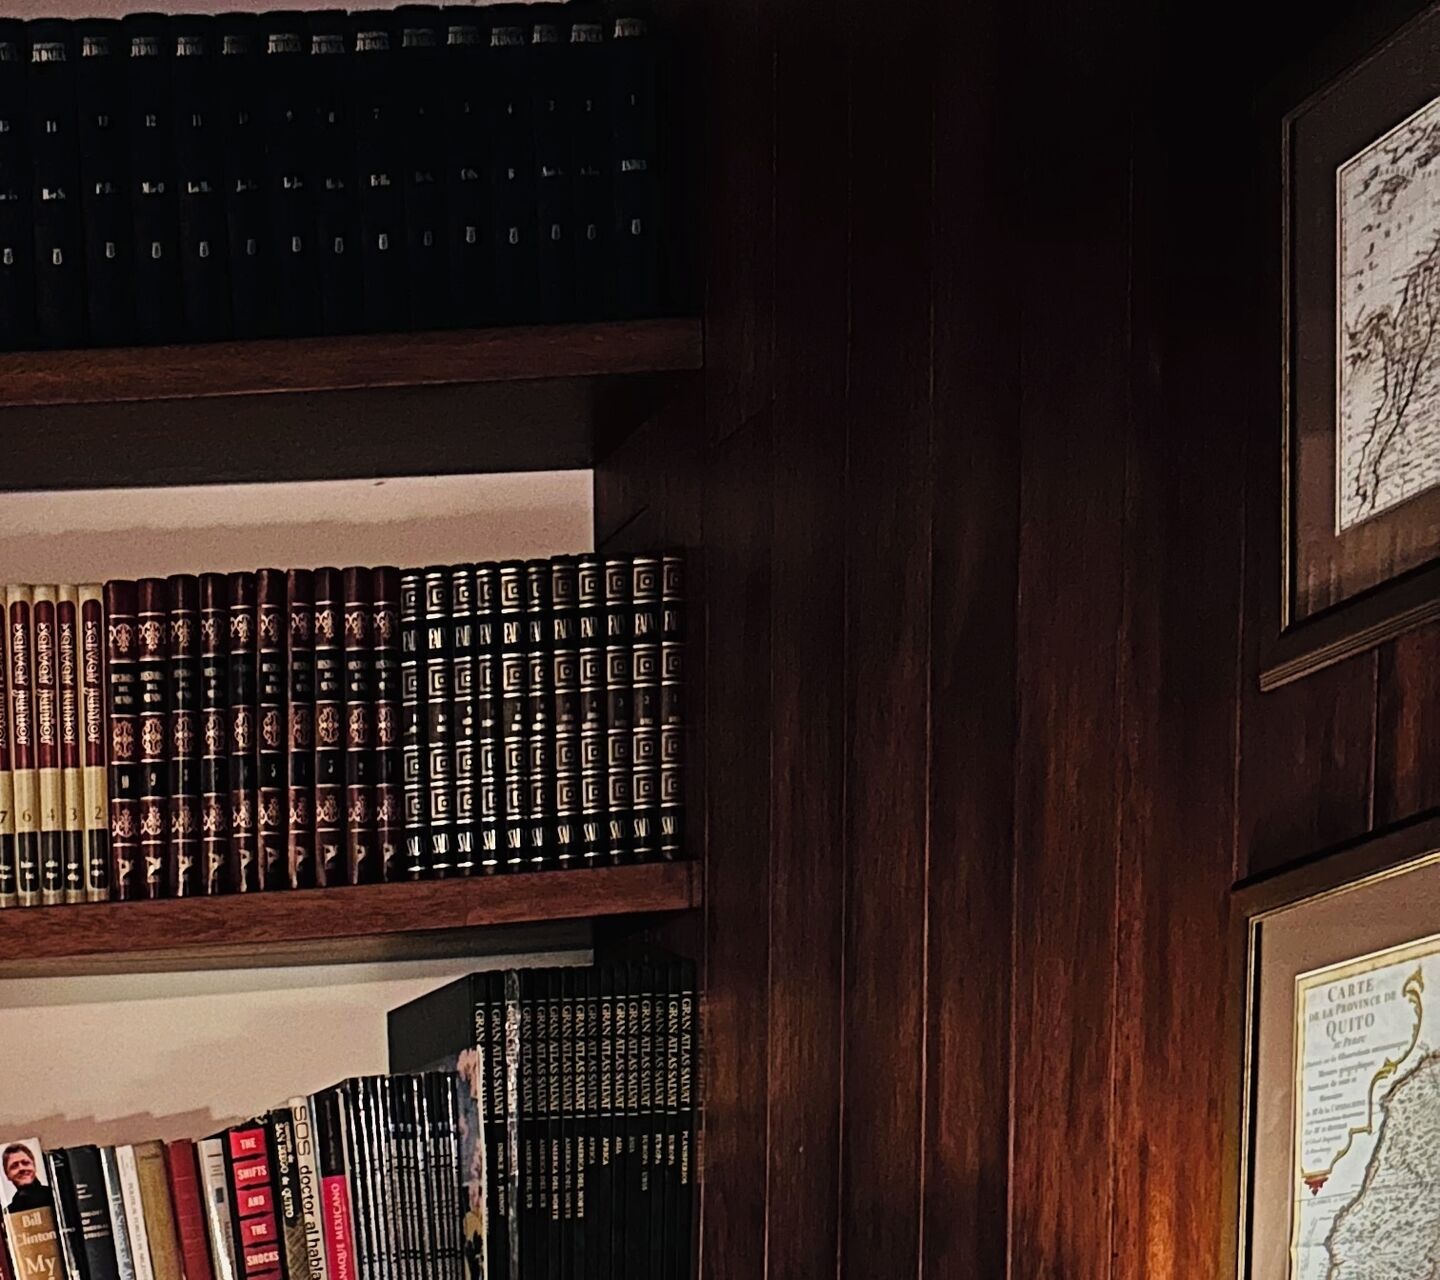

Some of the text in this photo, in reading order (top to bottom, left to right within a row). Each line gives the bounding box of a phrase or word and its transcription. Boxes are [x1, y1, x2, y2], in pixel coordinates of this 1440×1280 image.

[1327, 978, 1375, 1003] CARTE
[1335, 994, 1381, 1017] PROVINCE
[1326, 1012, 1376, 1042] QUITO
[679, 996, 692, 1104] GRAN ATLAS SALVAT
[292, 1104, 311, 1157] SOS
[239, 1168, 267, 1180] SHIFTS
[298, 1164, 317, 1218] doctor
[22, 1214, 42, 1228] Bill
[330, 1182, 344, 1240] MEXICANO
[250, 1224, 268, 1236] THE
[303, 1219, 319, 1236] al
[26, 1255, 55, 1277] My
[246, 1250, 279, 1266] SHOCKS
